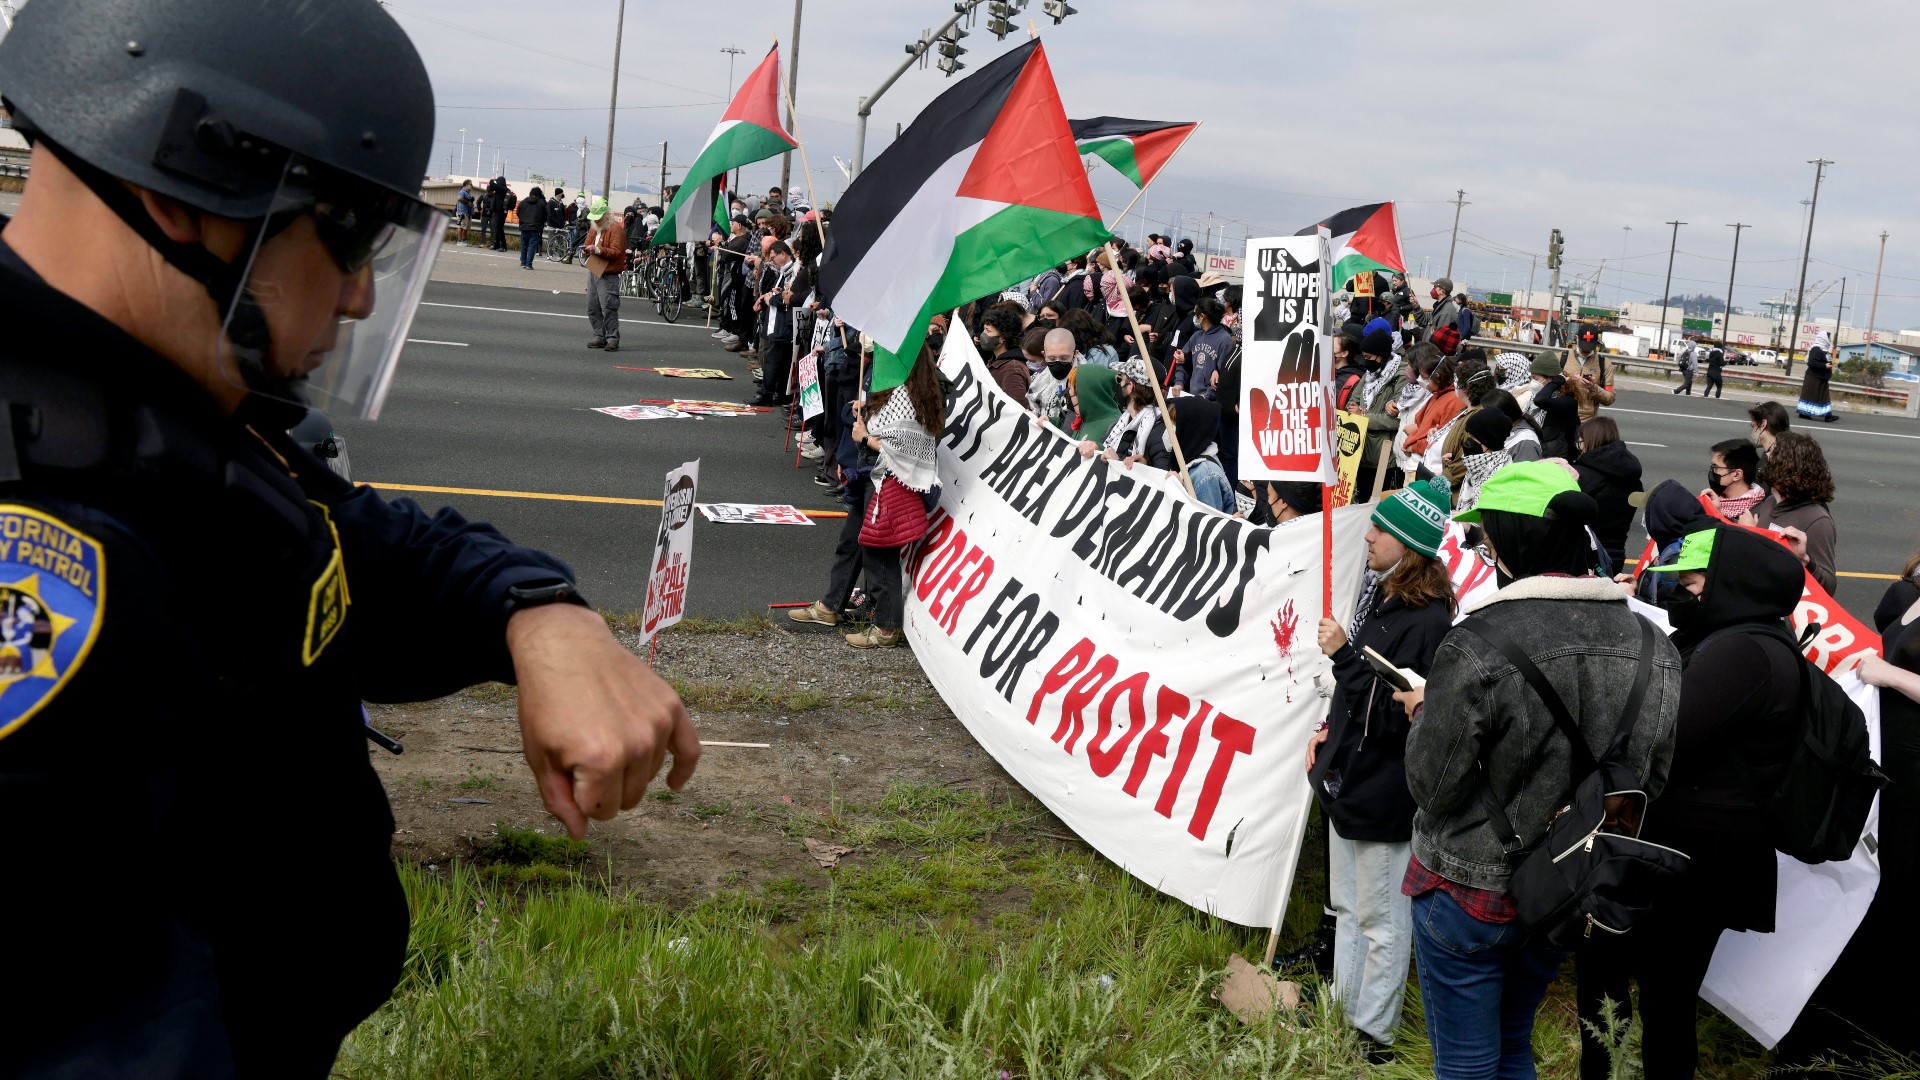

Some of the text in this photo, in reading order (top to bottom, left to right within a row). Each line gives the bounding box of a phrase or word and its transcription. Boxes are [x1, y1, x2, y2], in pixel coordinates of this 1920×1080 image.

[1209, 257, 1235, 270] ONE
[1261, 249, 1292, 272] U.S.
[1279, 298, 1314, 323] IS A
[1737, 333, 1756, 345] ONE
[1802, 325, 1820, 335] ONE
[1800, 340, 1814, 351] ON
[1280, 408, 1309, 430] THE
[938, 361, 1273, 637] BAY AREA DEMANDS
[17, 540, 93, 597] PATROL
[672, 552, 682, 566] for
[660, 562, 687, 597] PALE
[901, 505, 1256, 842] RDER FOR PROFIT
